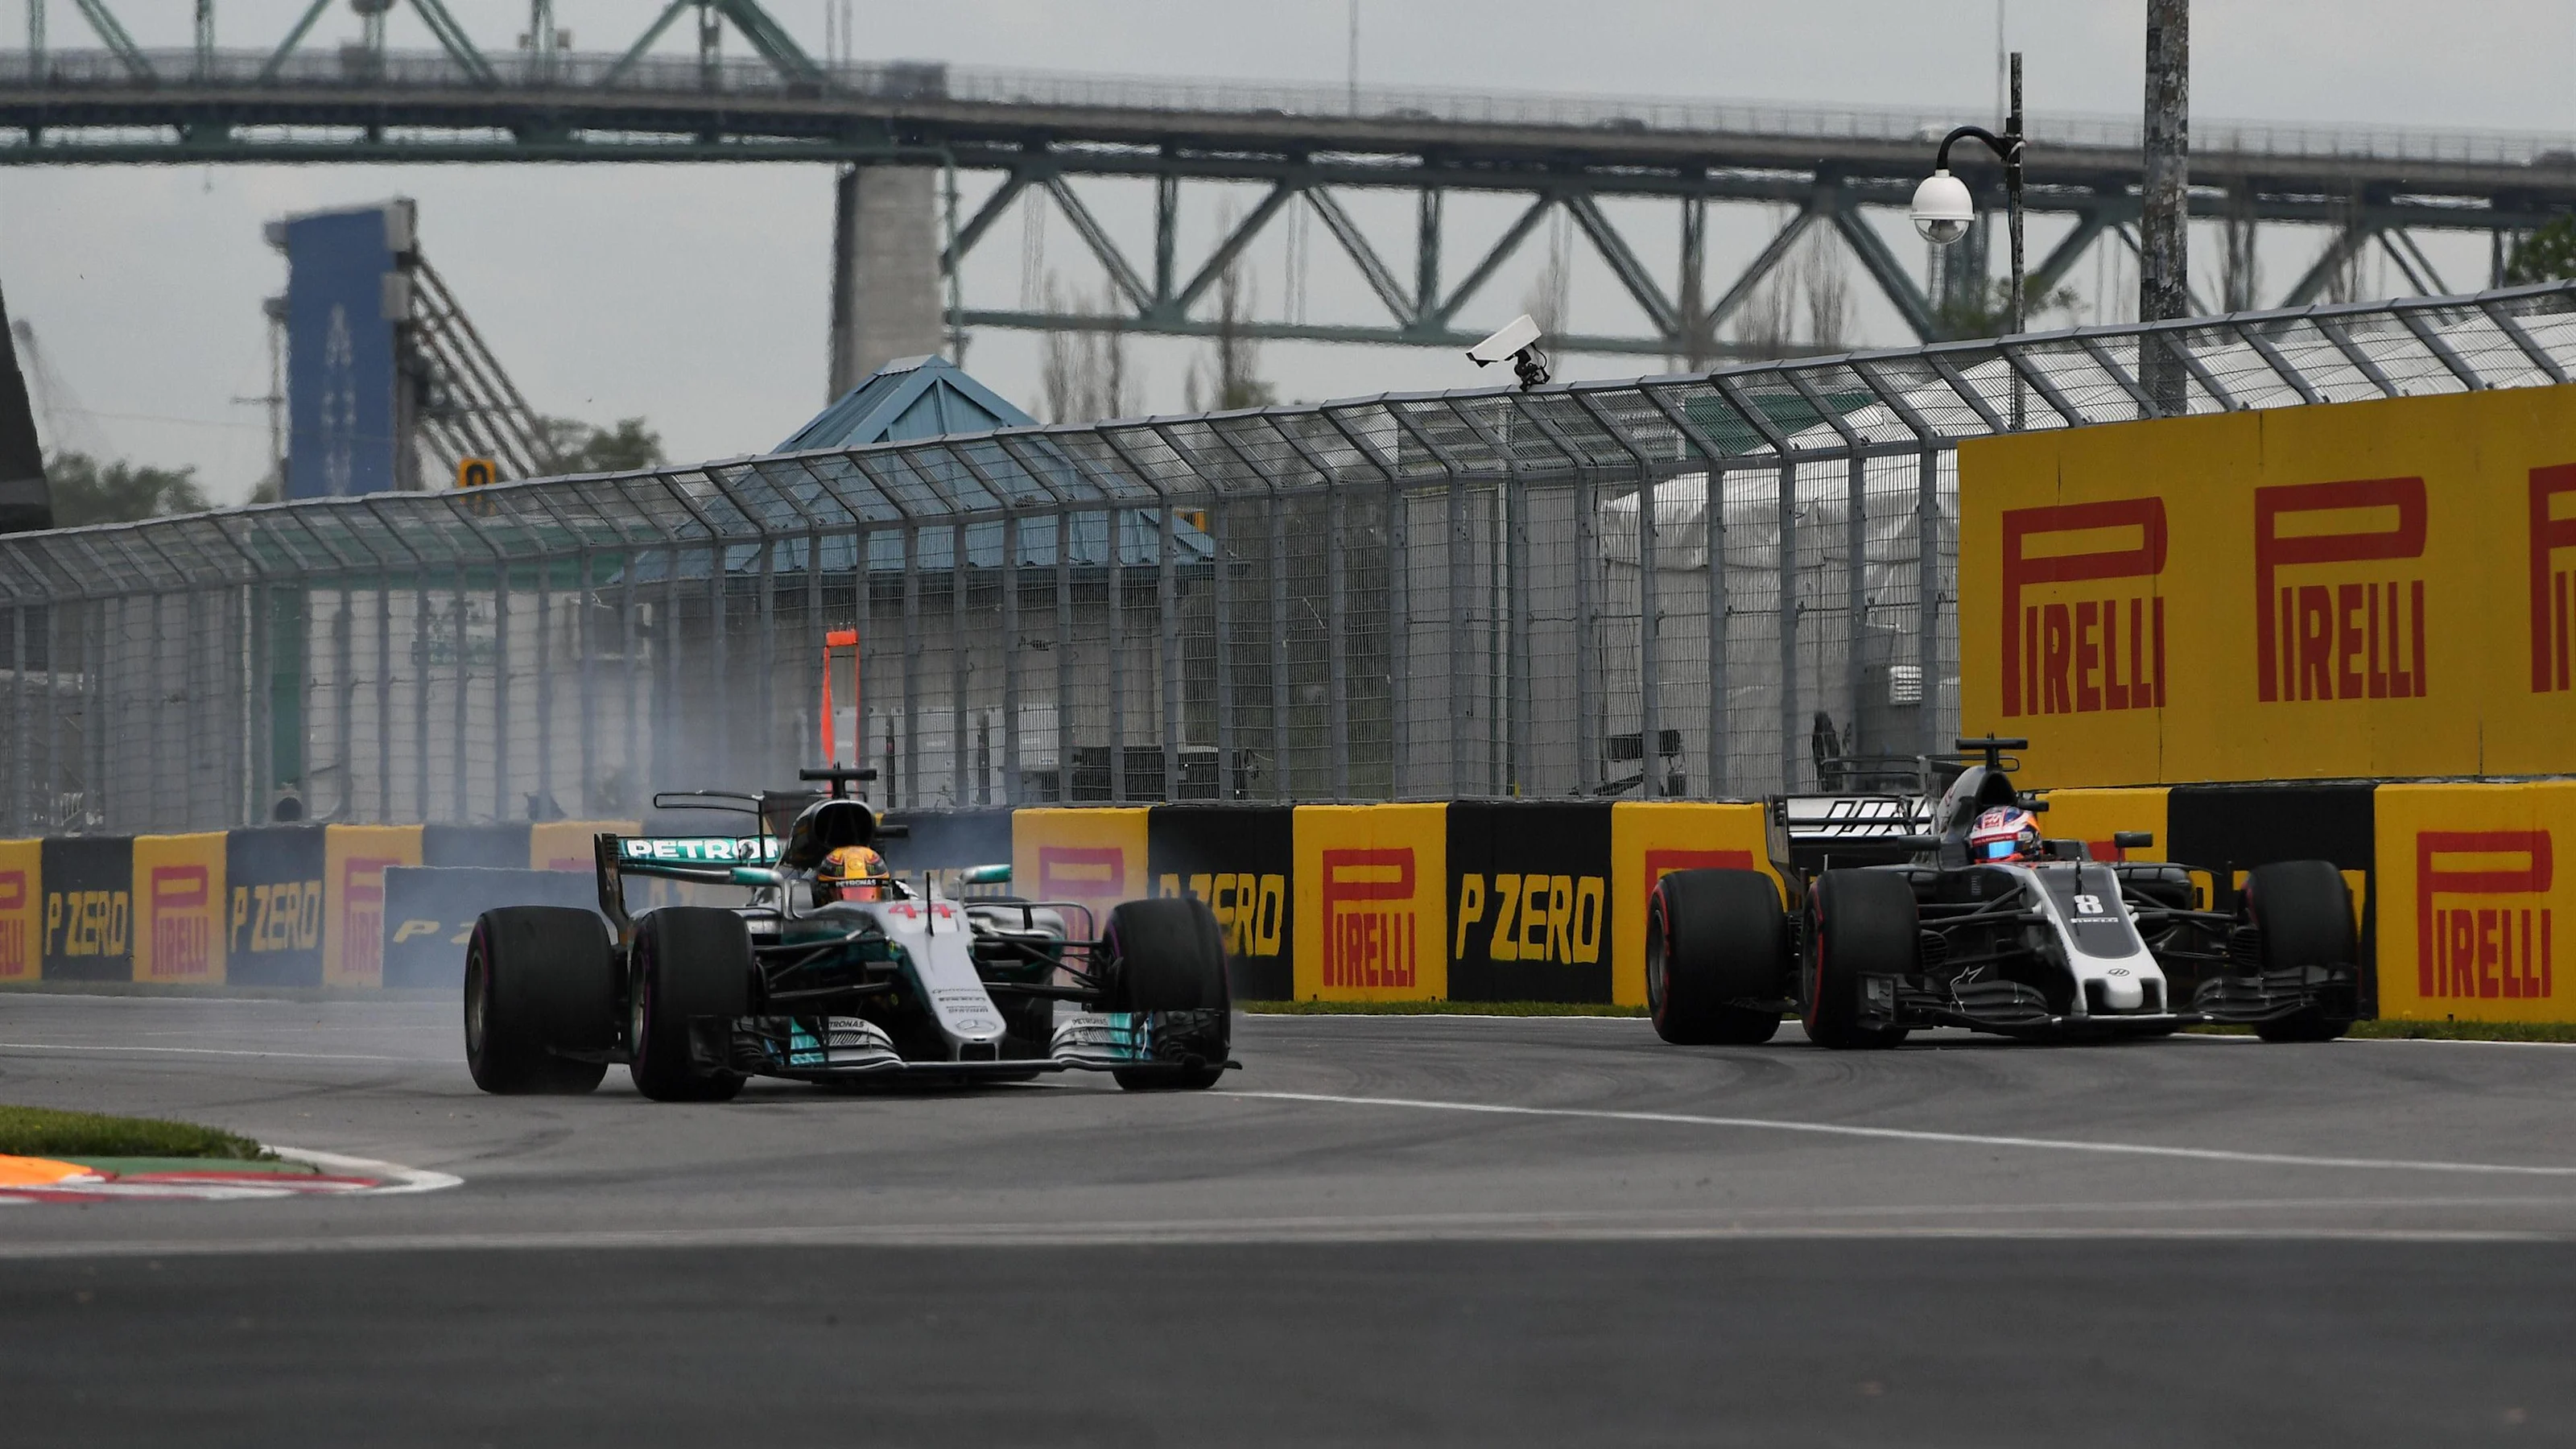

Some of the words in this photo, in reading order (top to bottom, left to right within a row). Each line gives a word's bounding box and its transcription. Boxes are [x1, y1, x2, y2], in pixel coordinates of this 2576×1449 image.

[2002, 496, 2167, 716] PIRELLI
[2255, 477, 2427, 702] PIRELLI
[46, 892, 62, 956] P
[65, 891, 128, 956] ZERO
[151, 865, 208, 976] PIRELLI
[231, 886, 248, 952] P
[250, 881, 321, 952] ZERO
[836, 878, 877, 887] PETRONAS
[1323, 848, 1415, 987] PIRELLI
[1456, 873, 1485, 960] P
[1489, 873, 1605, 964] ZERO
[2074, 894, 2104, 914] 8
[2417, 830, 2553, 998] PIRELLI
[393, 919, 440, 943] P
